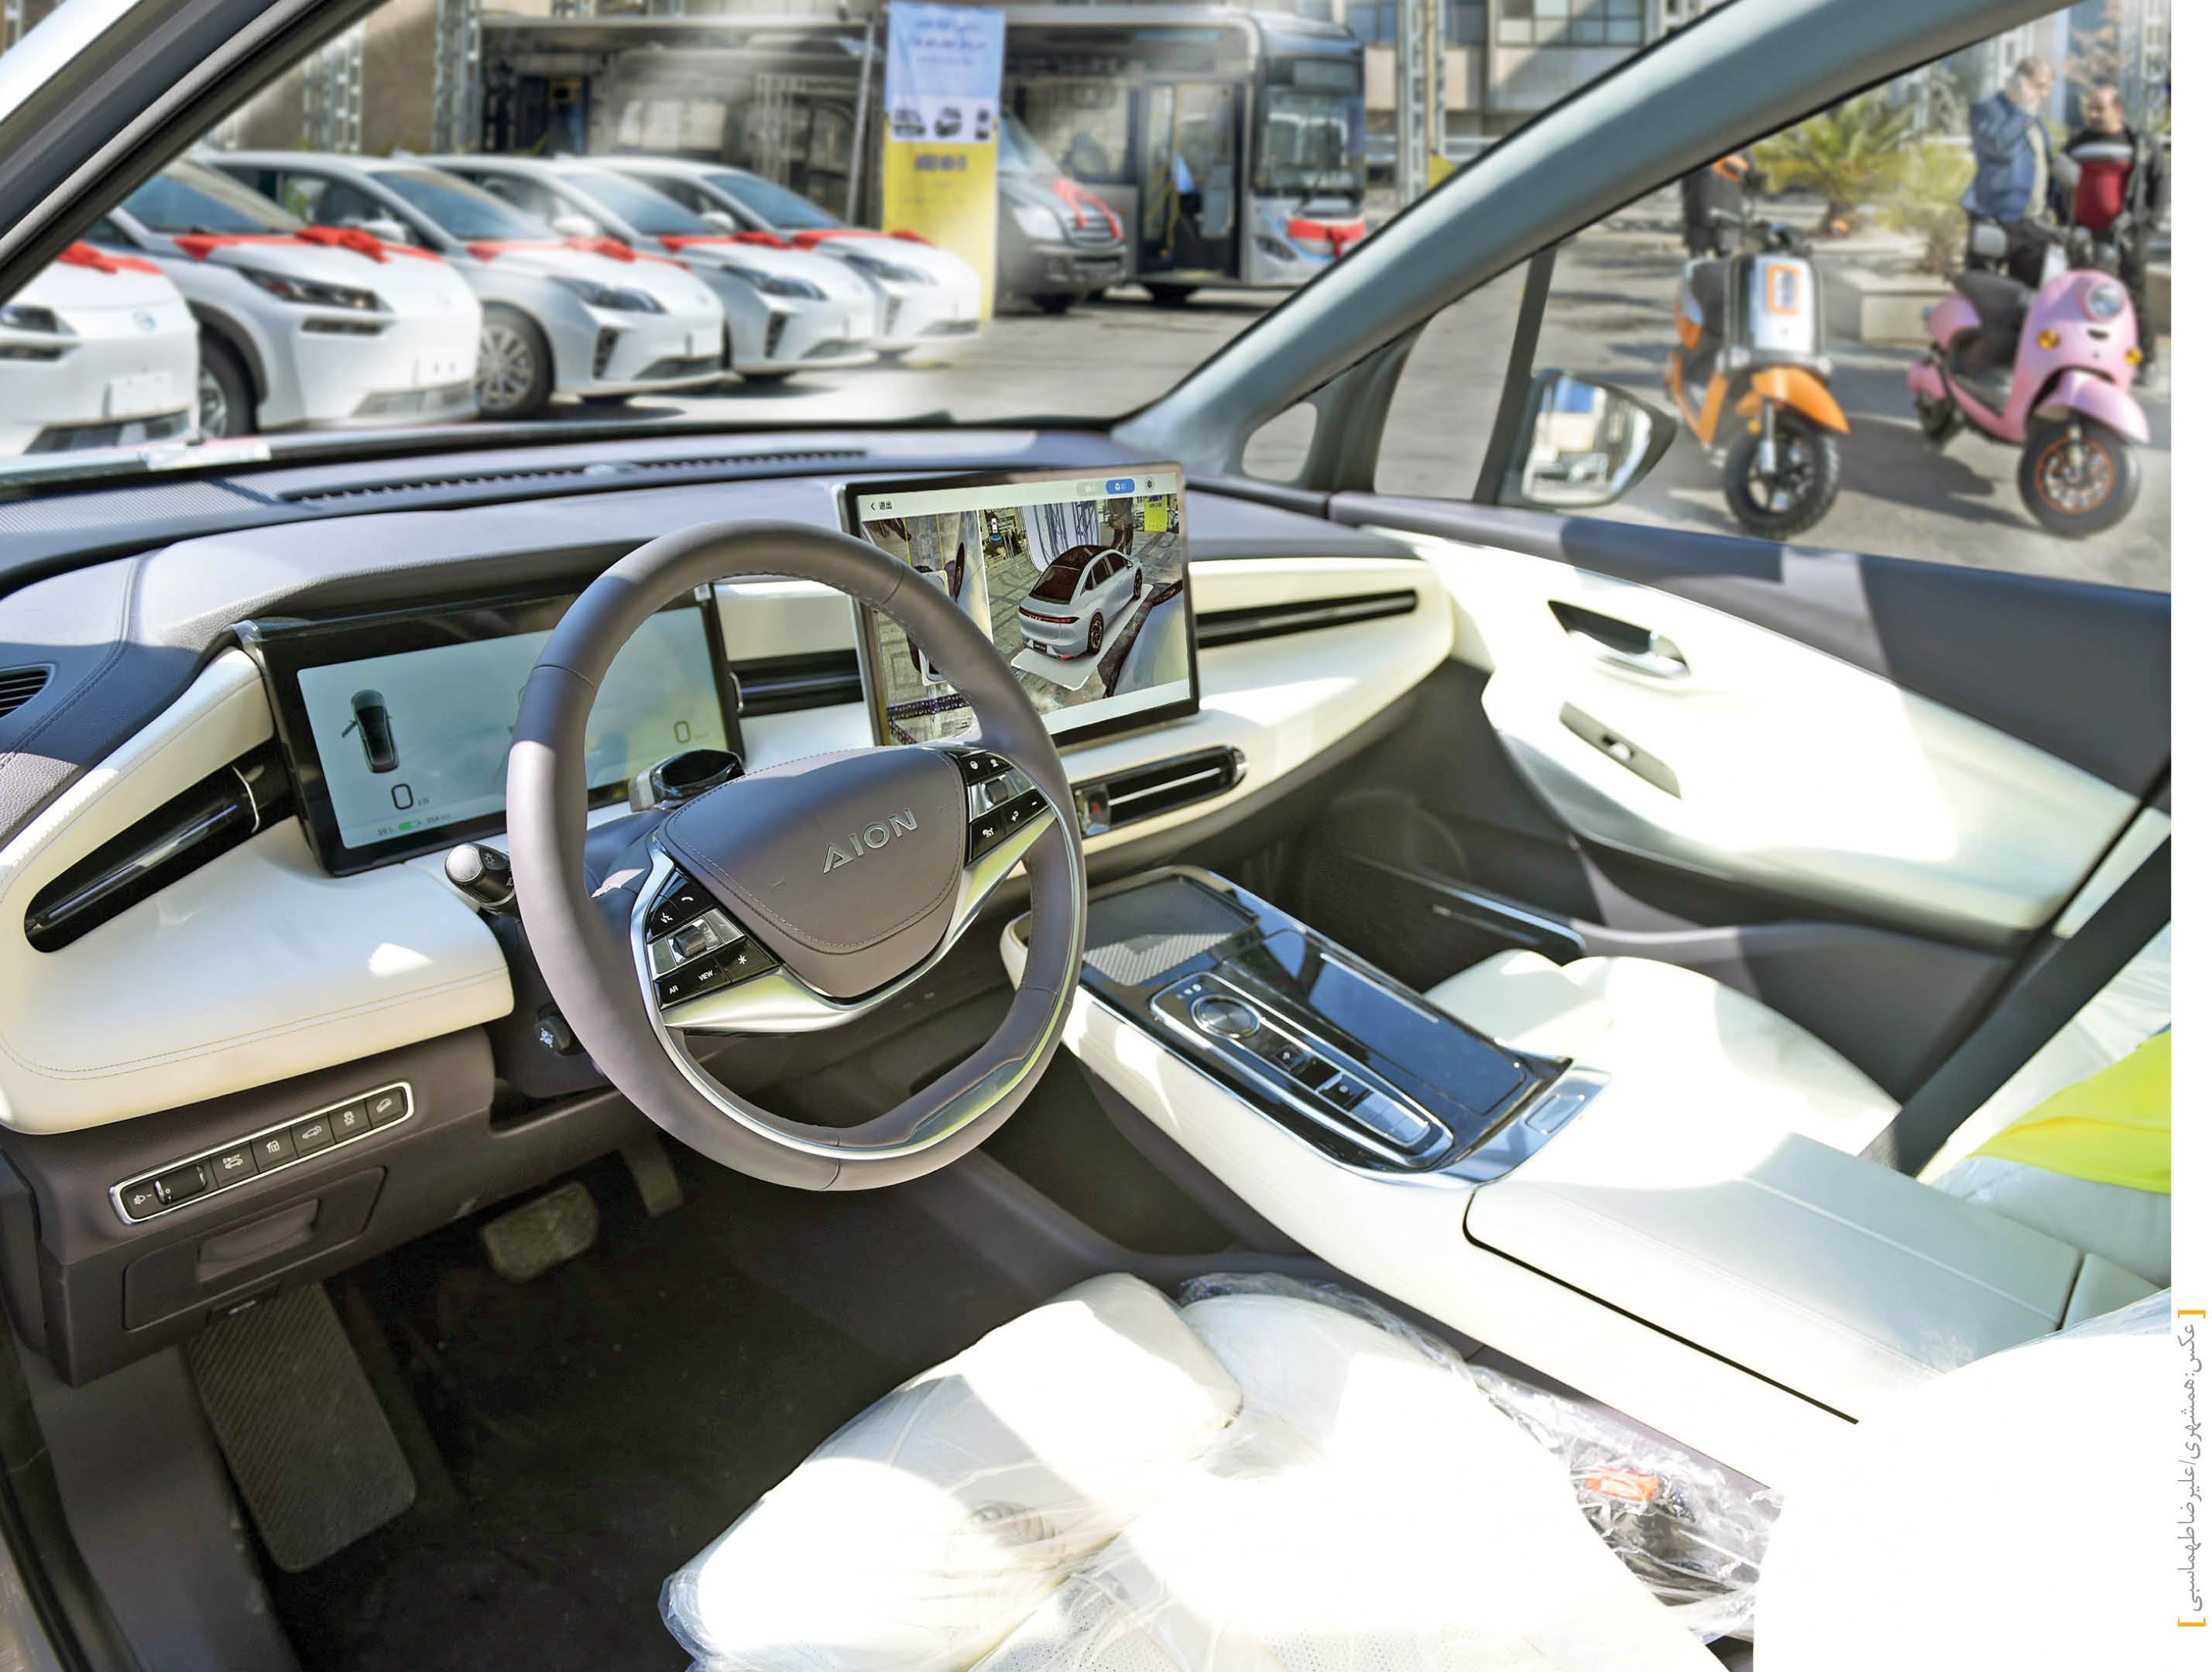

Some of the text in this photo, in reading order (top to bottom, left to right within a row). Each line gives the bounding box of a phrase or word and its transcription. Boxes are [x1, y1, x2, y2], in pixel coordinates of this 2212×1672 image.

[673, 720, 691, 744] 0
[390, 783, 413, 810] 0
[823, 807, 918, 875] AION
[669, 969, 714, 995] AR VIEW
